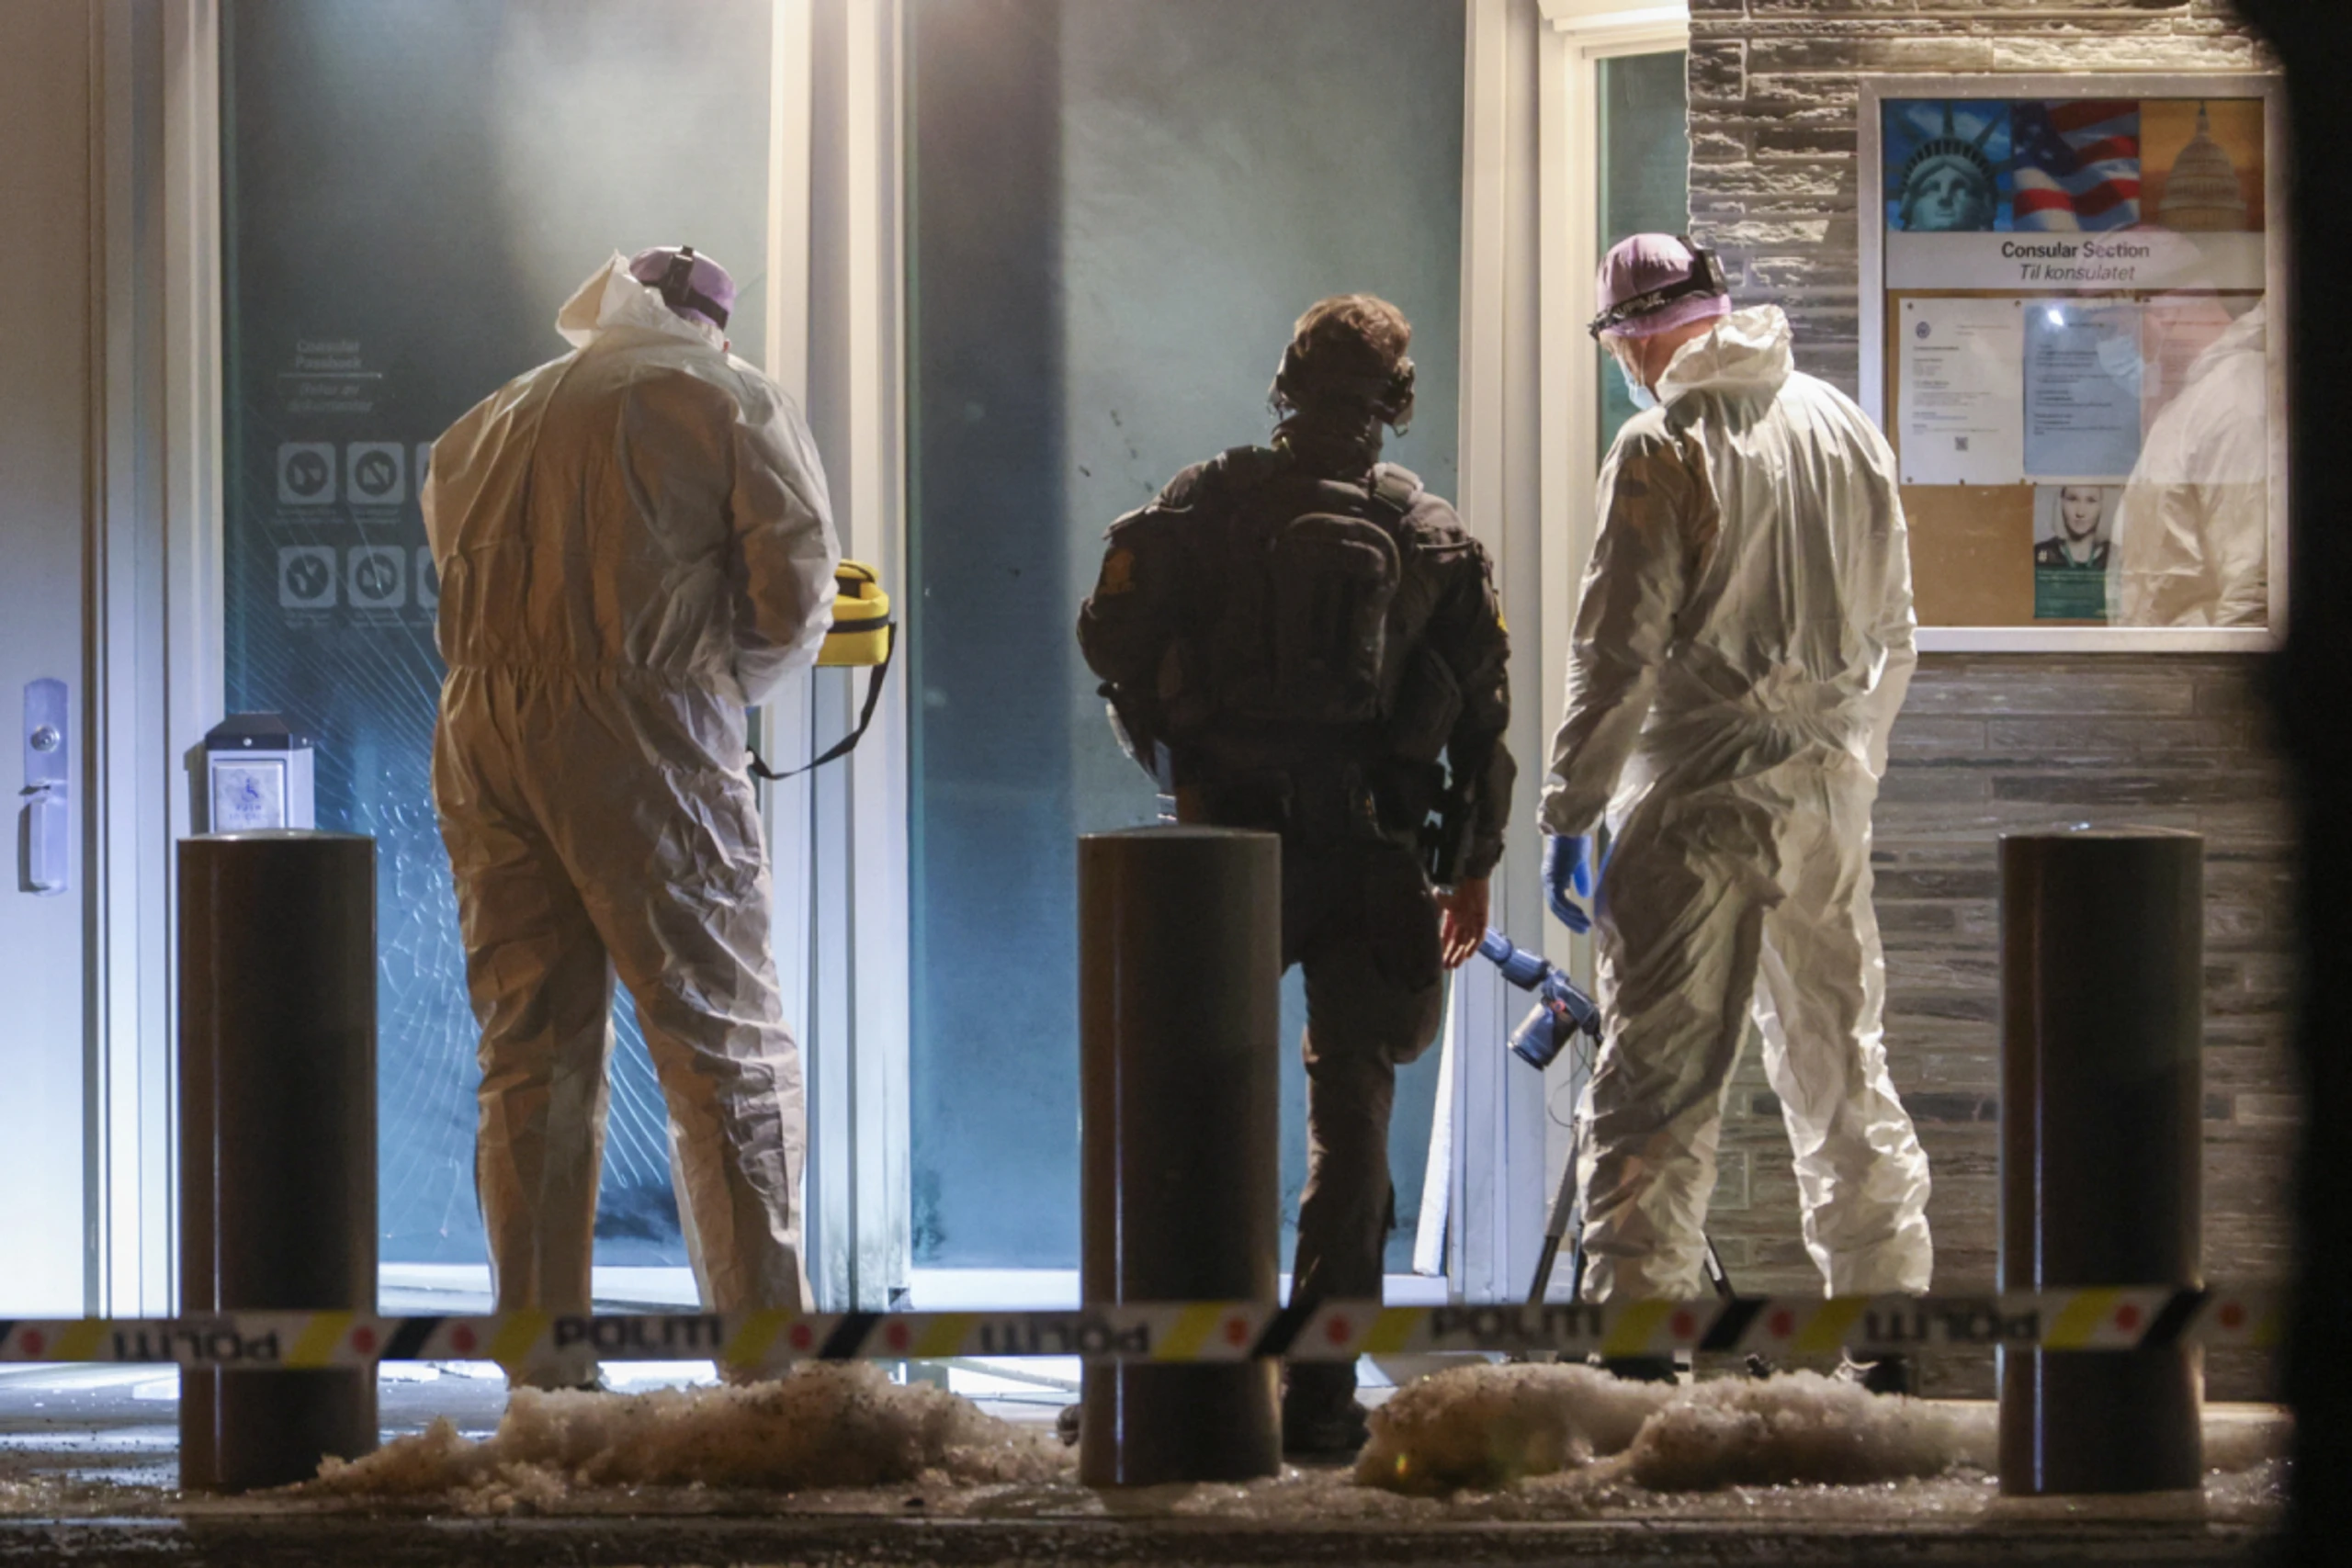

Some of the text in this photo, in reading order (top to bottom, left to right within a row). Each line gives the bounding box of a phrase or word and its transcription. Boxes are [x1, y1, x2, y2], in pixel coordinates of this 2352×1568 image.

[2001, 240, 2150, 260] Consular Section
[2019, 263, 2136, 281] Til konsulatet
[555, 1316, 722, 1354] POLITI
[980, 1320, 1148, 1356] POLITI
[1432, 1307, 1602, 1345] POLITI
[1864, 1307, 2039, 1343] POLITI
[113, 1327, 279, 1361] POLITI
